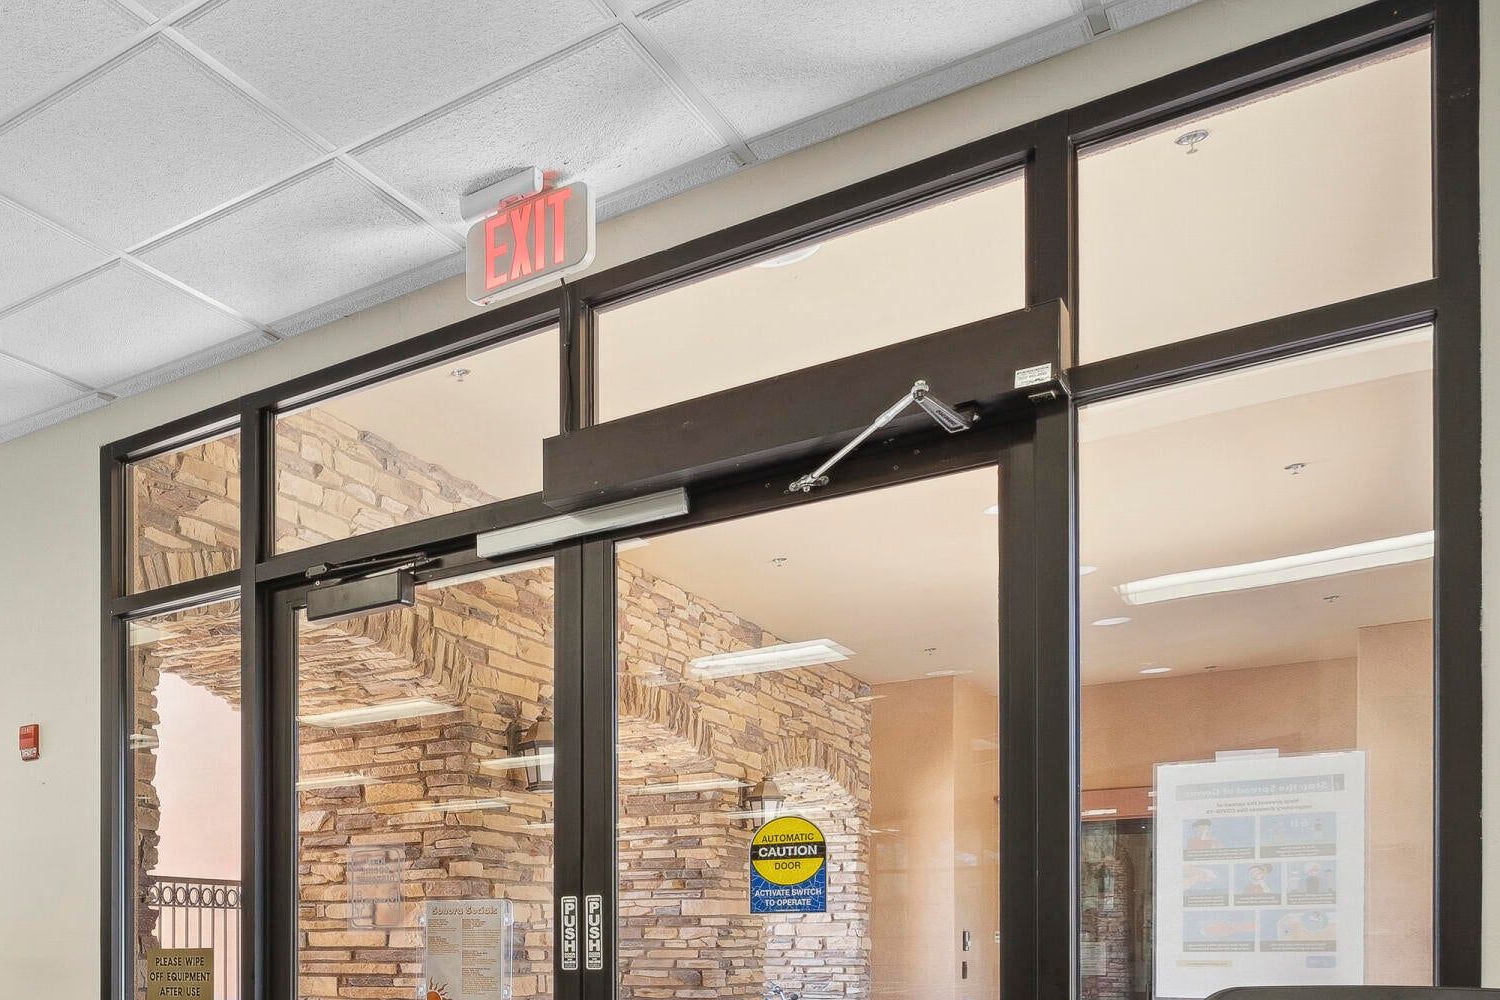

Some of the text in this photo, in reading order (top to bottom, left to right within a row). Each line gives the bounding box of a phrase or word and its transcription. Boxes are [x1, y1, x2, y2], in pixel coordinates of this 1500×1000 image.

[485, 187, 572, 291] EXIT
[762, 833, 814, 843] AUTOMATIC
[758, 845, 818, 857] CAUTION
[774, 861, 801, 870] DOOR
[755, 888, 822, 897] ACTIVATE SWITCH
[765, 898, 812, 907] TO OPERATE
[432, 906, 498, 915] Sonora Socials
[564, 902, 576, 952] PUSH
[588, 901, 601, 952] PUSH
[155, 956, 204, 967] PLEASE WIPE
[150, 972, 211, 981] OFF EQUIPMENT
[160, 987, 201, 996] AFTER USE
